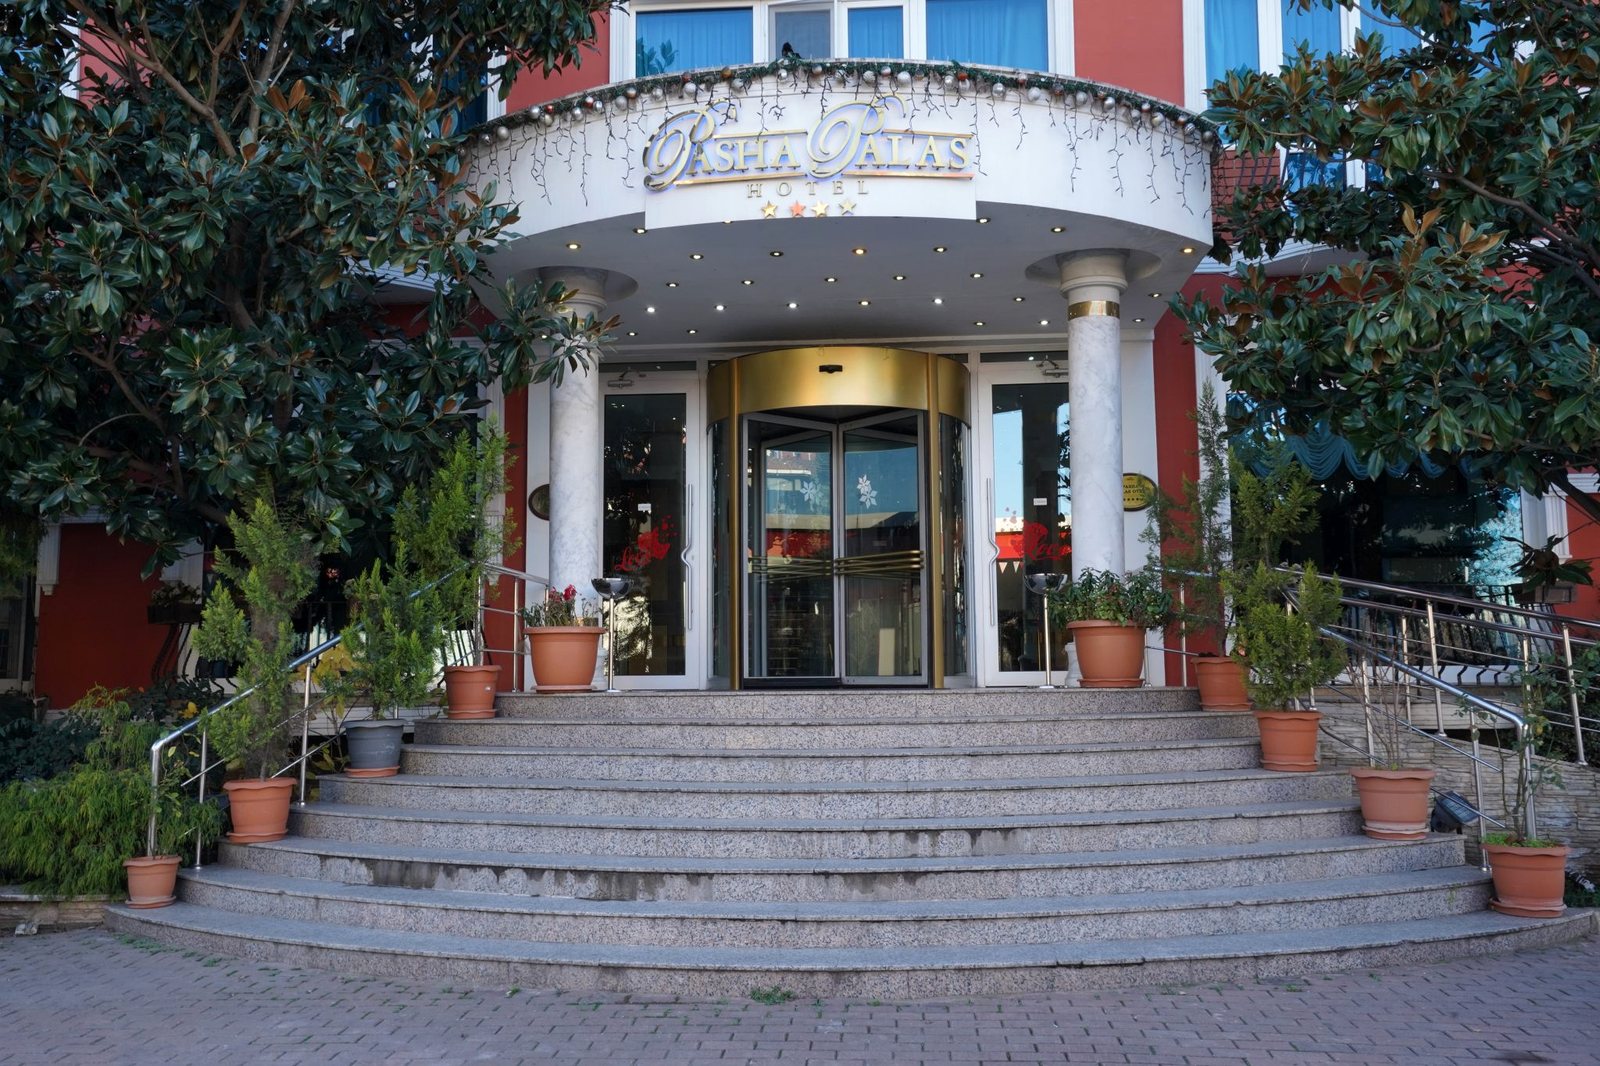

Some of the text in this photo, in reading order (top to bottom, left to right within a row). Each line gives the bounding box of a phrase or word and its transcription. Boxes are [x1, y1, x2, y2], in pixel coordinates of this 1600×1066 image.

[643, 94, 968, 192] PASHA PALAS
[747, 180, 869, 199] HOTEL
